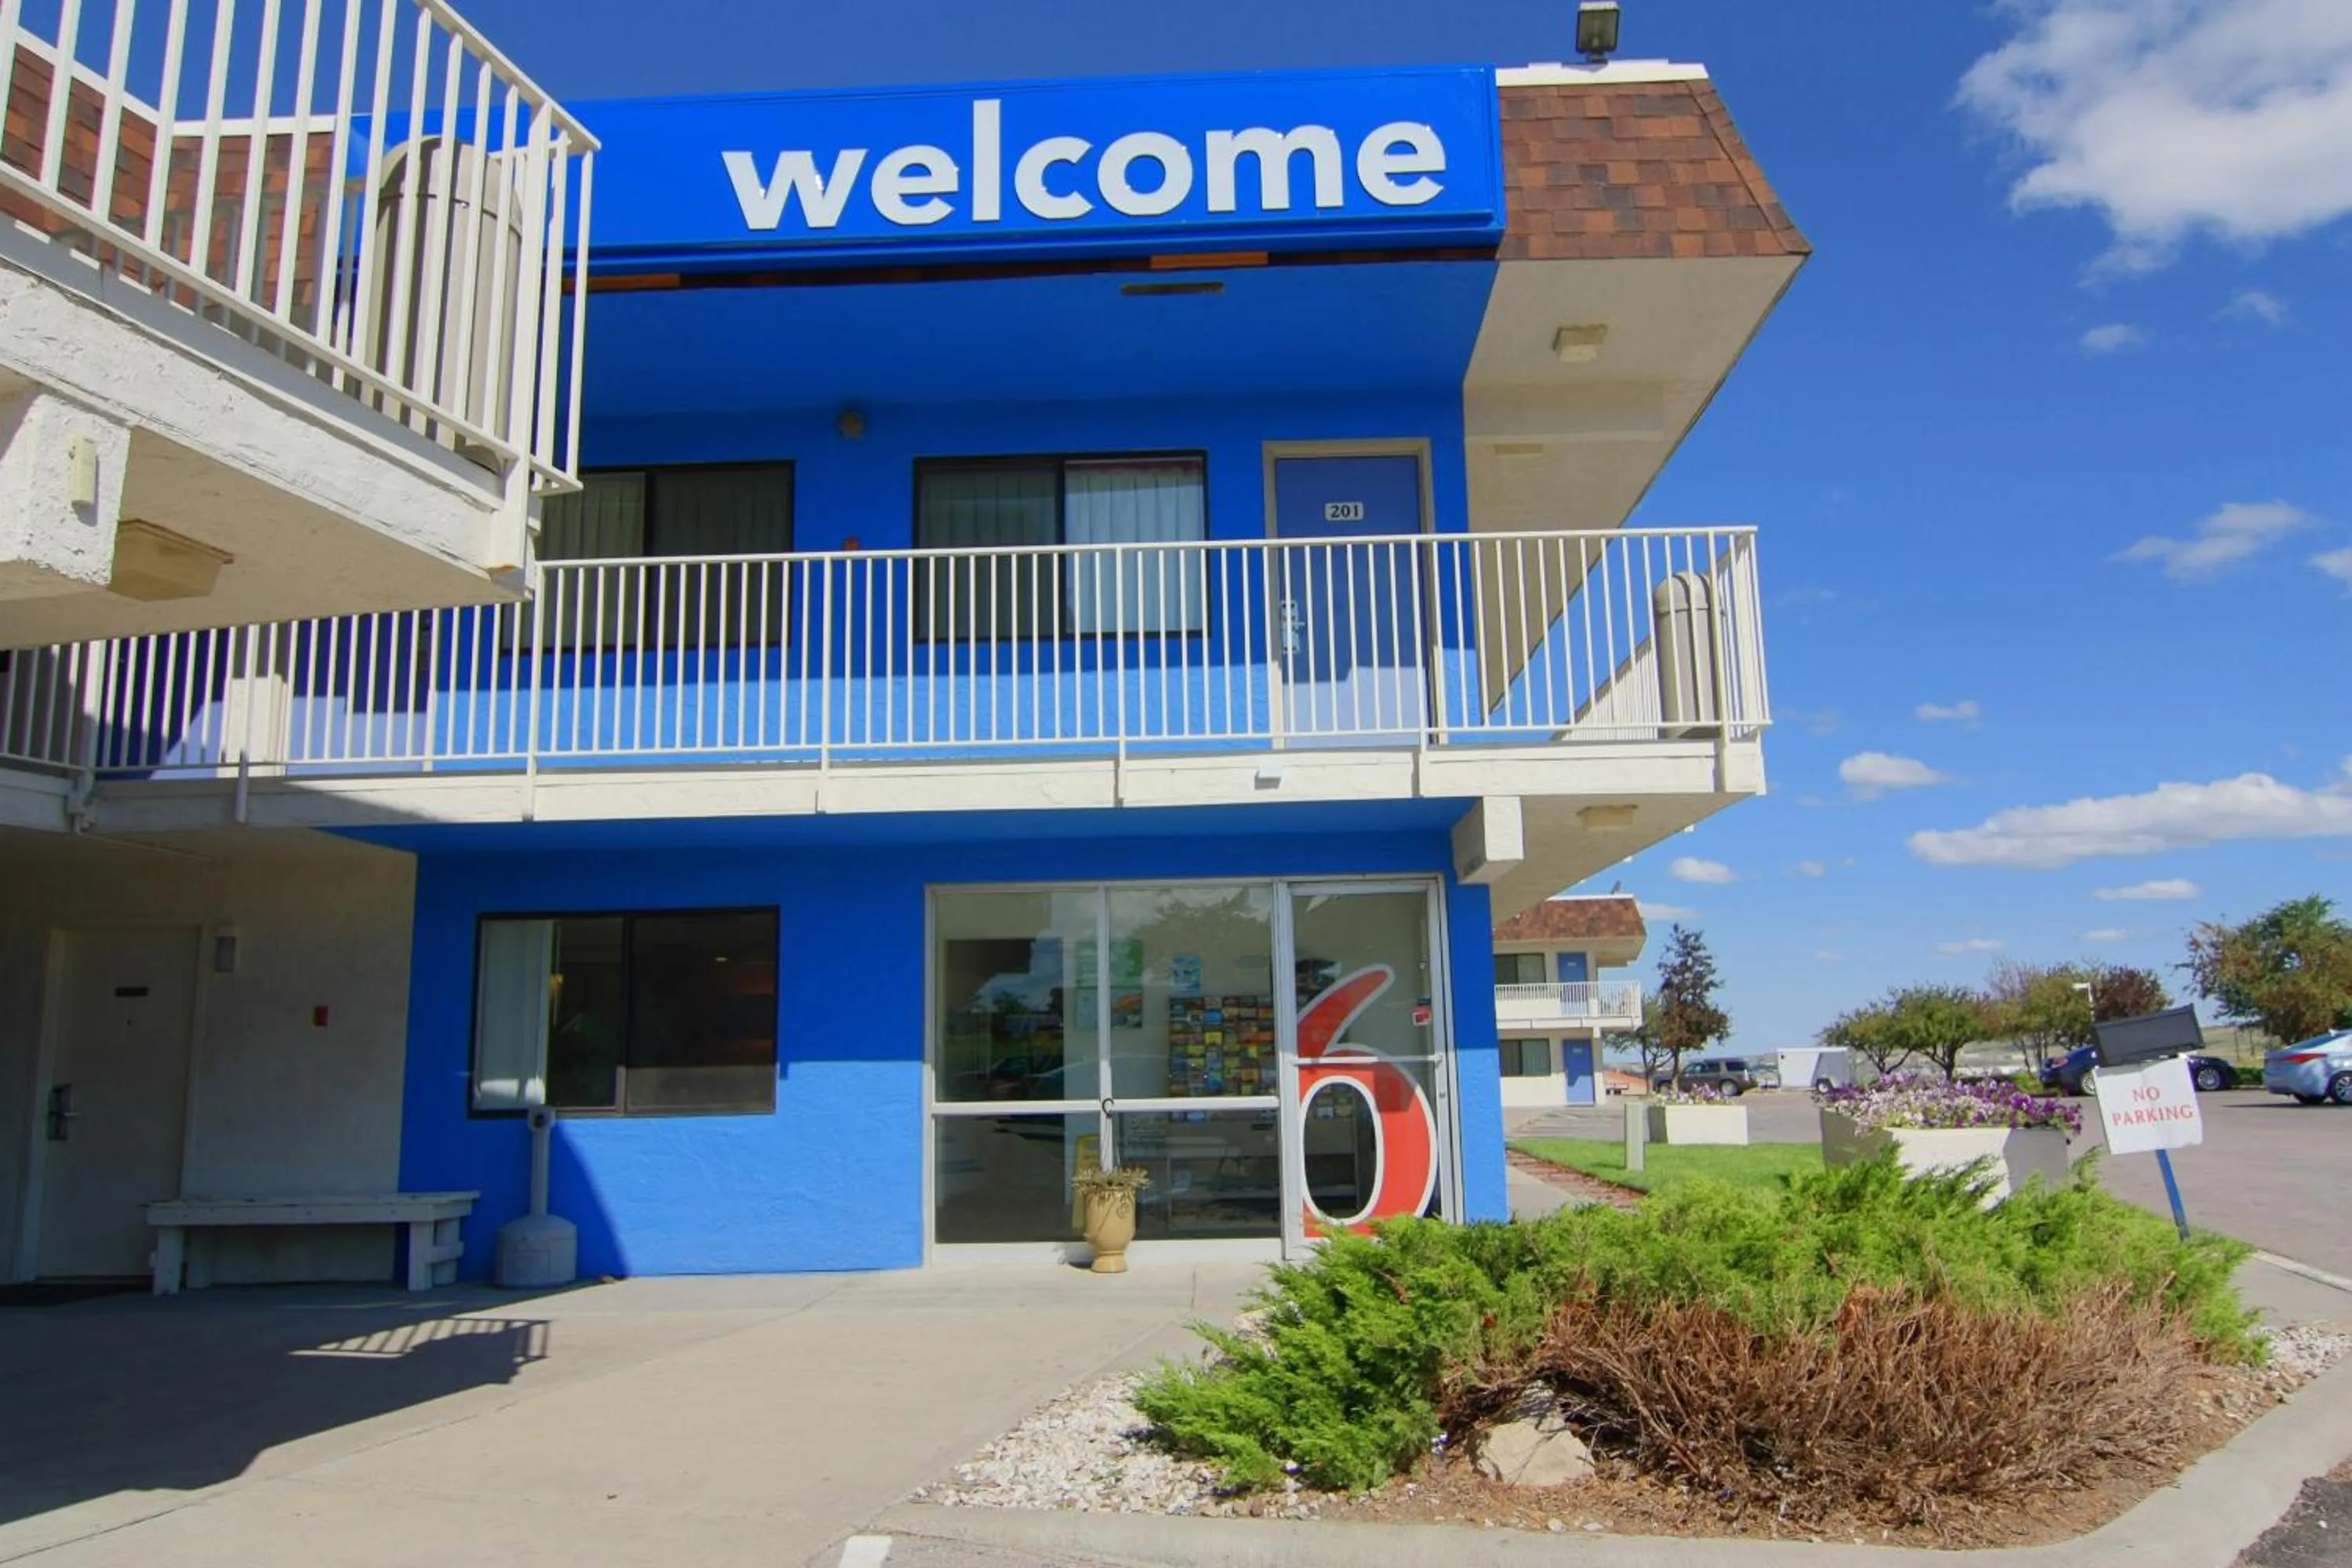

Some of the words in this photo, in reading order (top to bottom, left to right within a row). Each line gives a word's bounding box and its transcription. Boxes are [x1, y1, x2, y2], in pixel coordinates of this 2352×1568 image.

[720, 98, 1447, 230] welcome
[1330, 504, 1359, 518] 201
[1296, 964, 1439, 1239] 6
[2132, 1086, 2161, 1103] NO
[2111, 1104, 2194, 1127] PARKING
